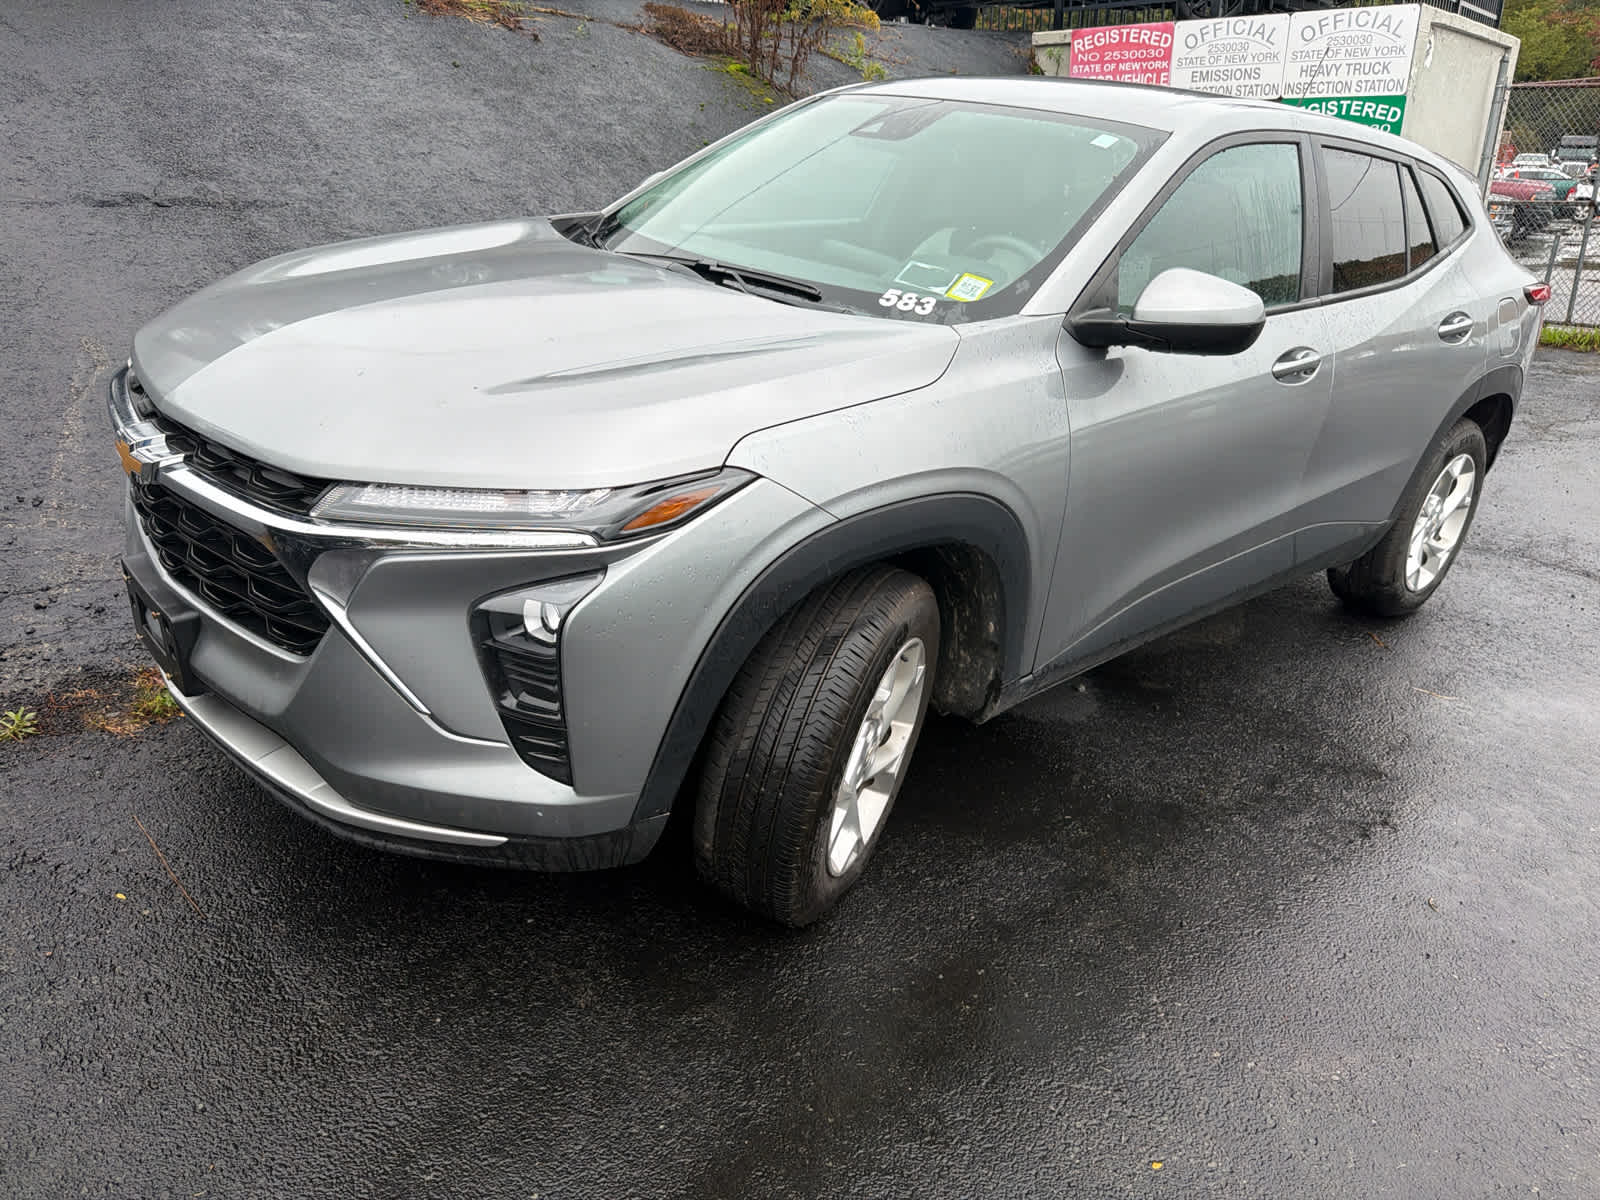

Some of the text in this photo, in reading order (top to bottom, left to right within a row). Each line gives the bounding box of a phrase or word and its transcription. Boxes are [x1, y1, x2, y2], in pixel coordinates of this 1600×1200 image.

[1185, 19, 1276, 49] OFFICIAL
[1301, 10, 1404, 42] OFFICIAL
[1073, 28, 1172, 54] REGISTERED
[1208, 42, 1249, 54] 2530030
[1326, 34, 1373, 46] 2530030
[1078, 48, 1164, 62] NO 2530030
[1177, 51, 1280, 67] STATE OF NEW YORK
[1291, 44, 1406, 60] STATE OF NEW YORK
[1072, 63, 1101, 73] STATE
[1103, 63, 1117, 72] OF
[1191, 67, 1261, 83] EMISSIONS
[1300, 62, 1392, 78] HEAVY TRUCK
[1235, 83, 1280, 97] STATION
[1284, 78, 1405, 96] INSPECTION STATION
[878, 288, 937, 315] 583
